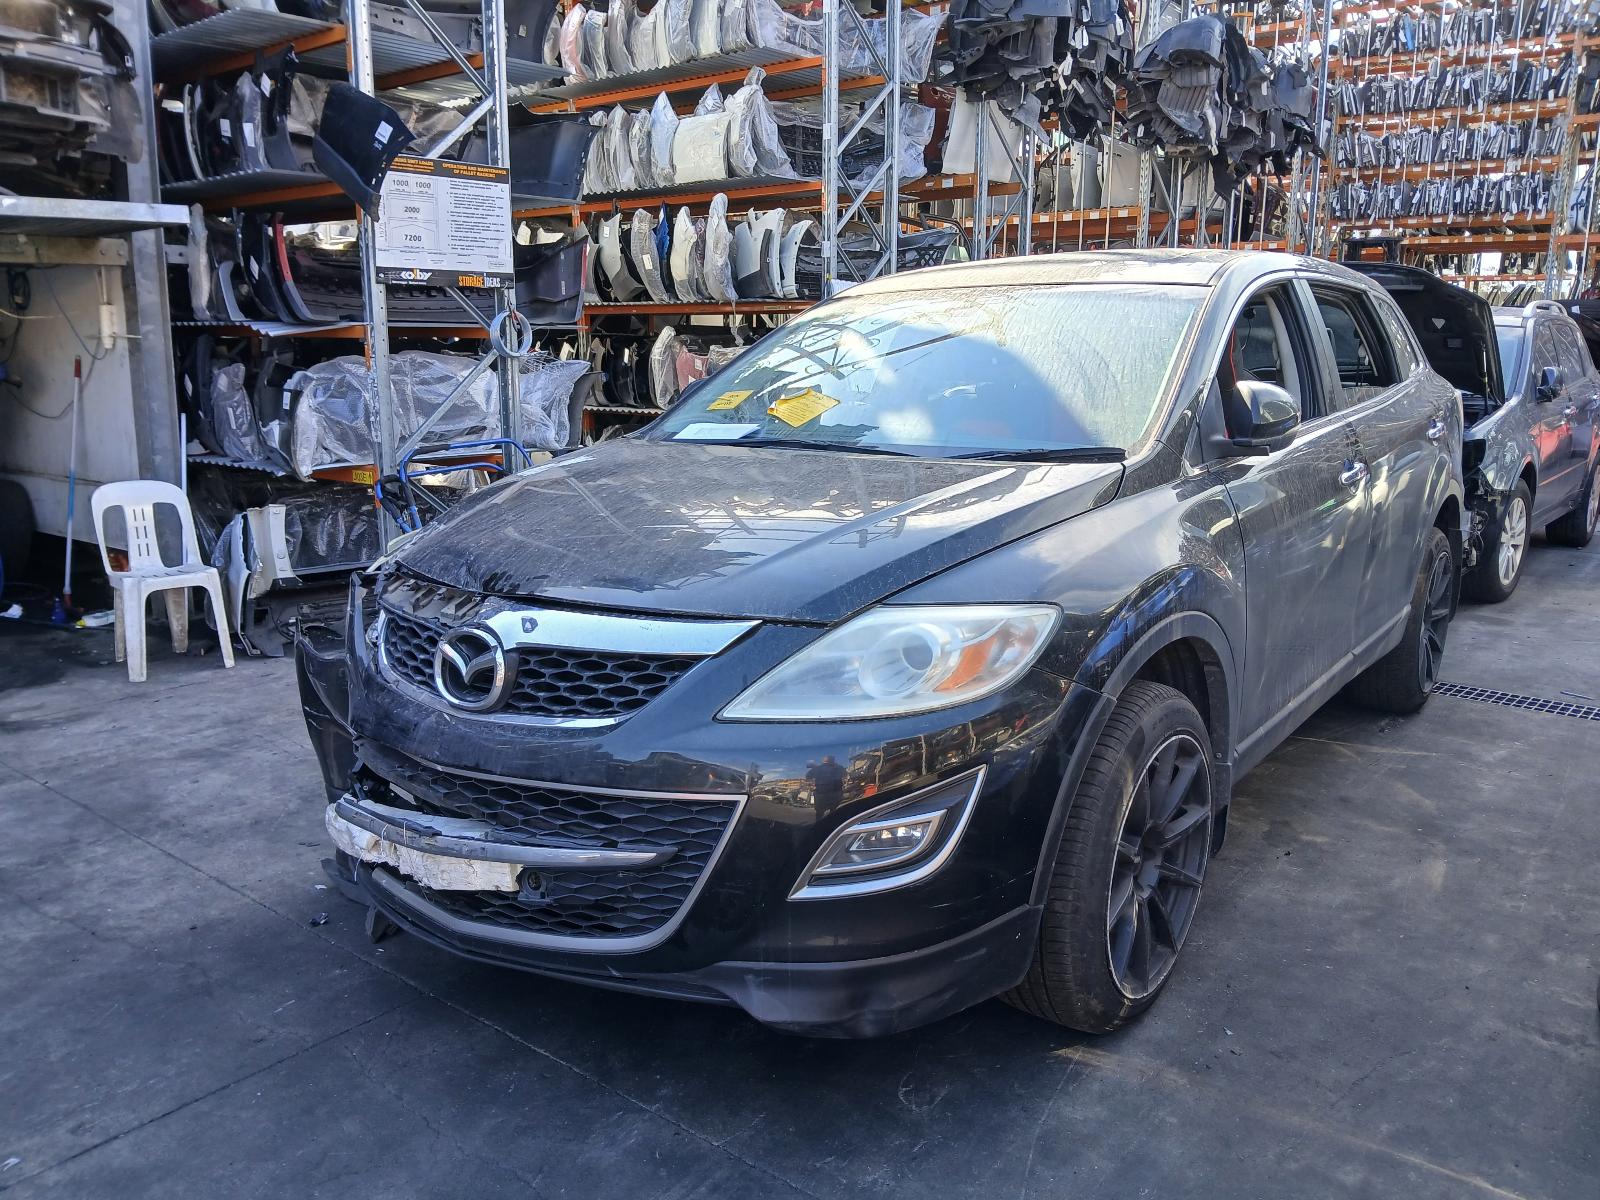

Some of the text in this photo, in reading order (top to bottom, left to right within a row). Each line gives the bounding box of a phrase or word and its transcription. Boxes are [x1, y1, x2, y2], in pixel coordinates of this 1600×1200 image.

[477, 167, 507, 175] MAINTENANCE
[392, 179, 409, 187] 1000
[458, 275, 483, 287] STORAGE
